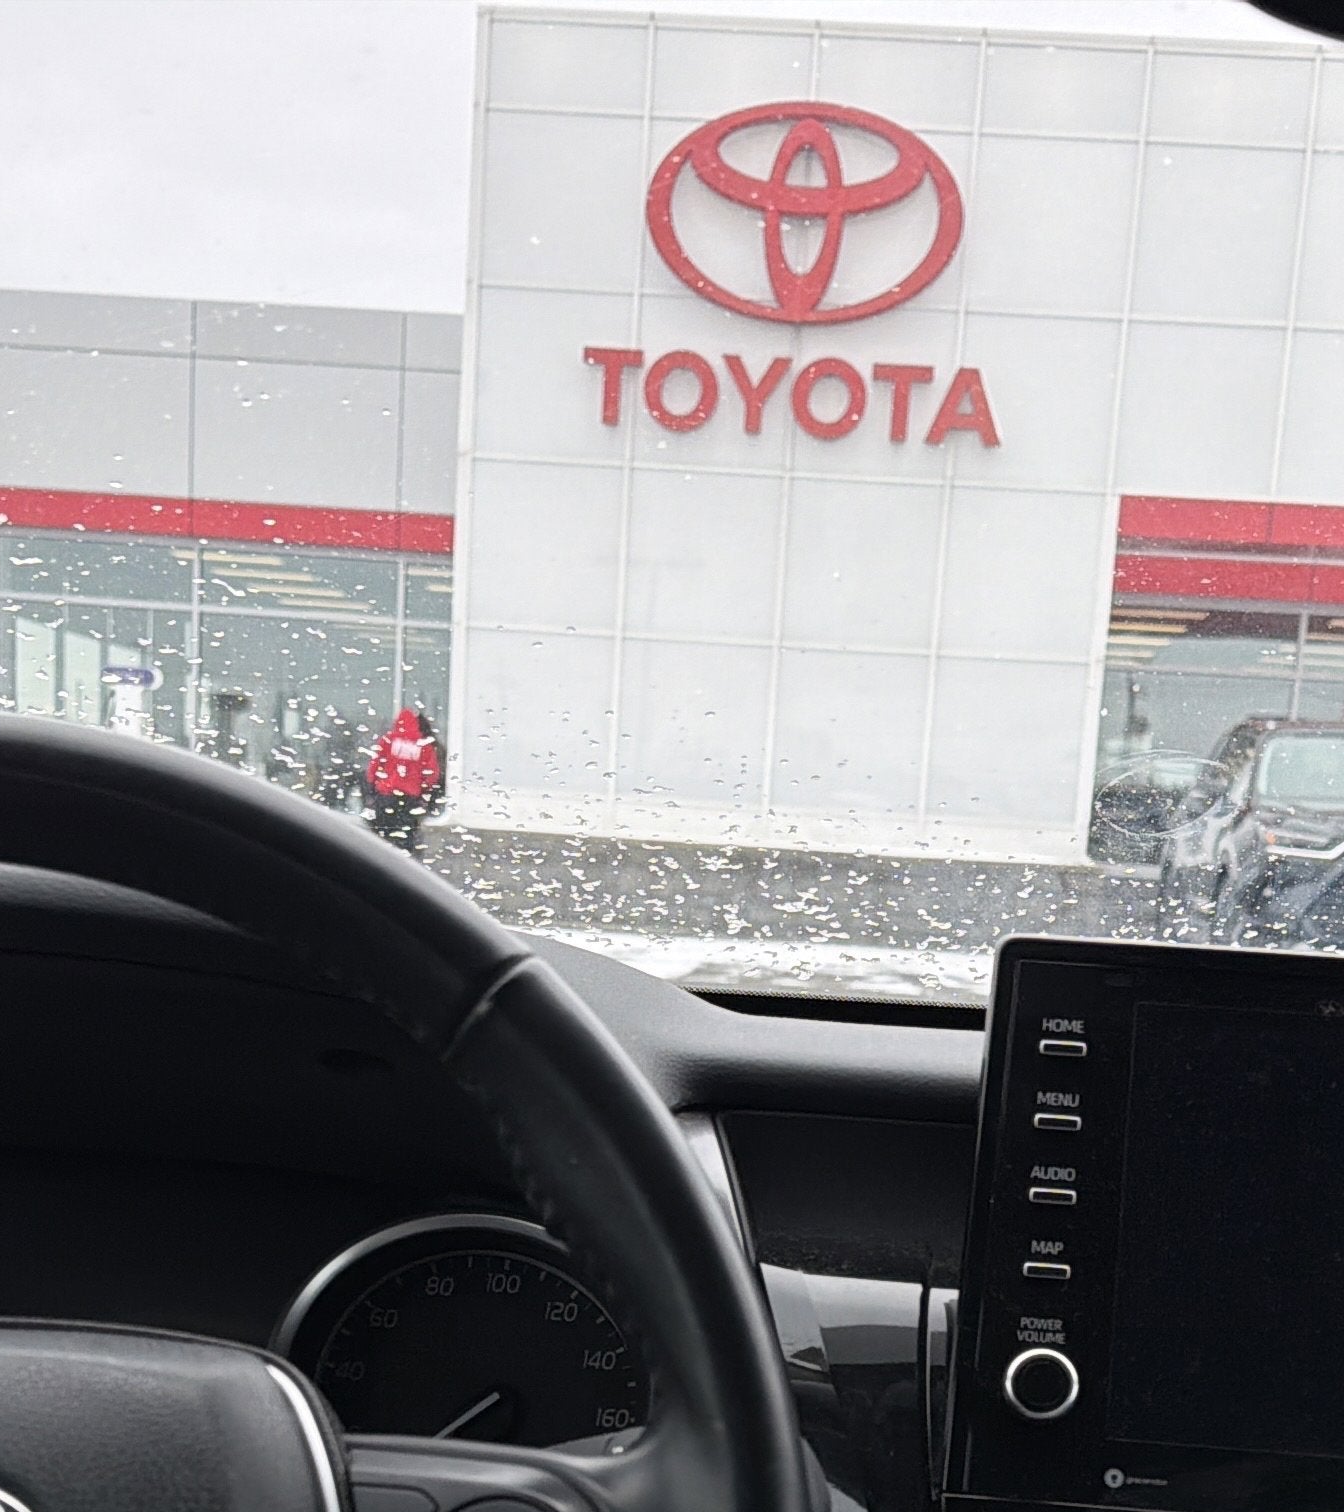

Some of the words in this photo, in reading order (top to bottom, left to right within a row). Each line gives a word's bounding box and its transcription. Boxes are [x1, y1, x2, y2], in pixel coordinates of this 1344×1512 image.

[583, 346, 1001, 448] TOYOTA
[1042, 1019, 1085, 1035] HOME
[1036, 1092, 1080, 1108] MENU
[1030, 1166, 1076, 1182] AUDIO
[1031, 1240, 1064, 1256] MAP
[425, 1277, 455, 1297] 80
[485, 1274, 520, 1293] 100
[369, 1310, 398, 1329] 60
[544, 1303, 578, 1322] 120
[1020, 1317, 1063, 1331] POWER
[1017, 1330, 1067, 1345] VOLUME
[583, 1350, 617, 1371] 140
[595, 1409, 629, 1427] 160
